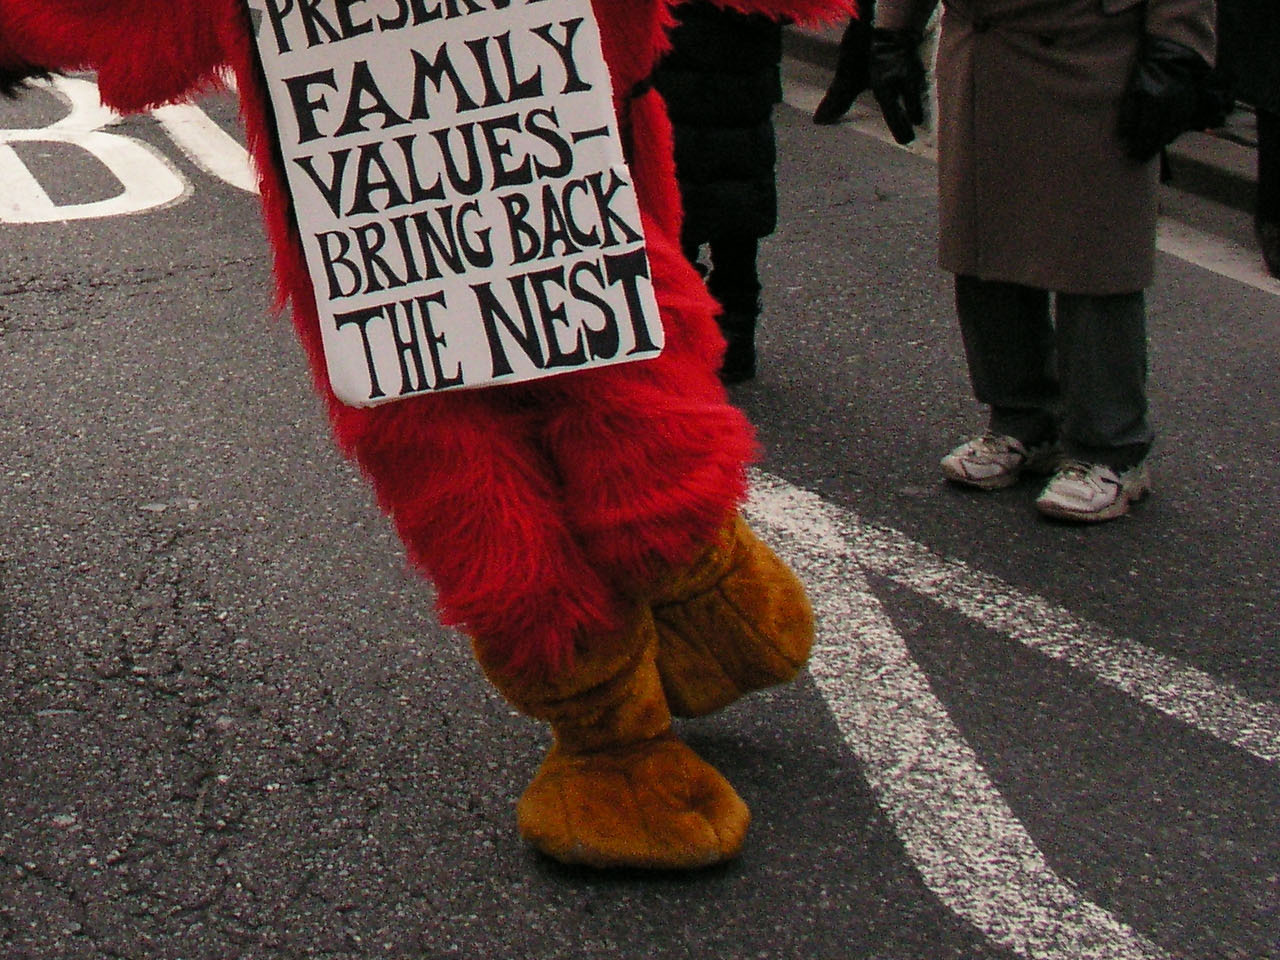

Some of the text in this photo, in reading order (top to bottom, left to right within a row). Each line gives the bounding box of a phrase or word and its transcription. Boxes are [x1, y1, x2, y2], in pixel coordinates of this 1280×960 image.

[281, 17, 592, 145] FAMILY
[314, 168, 644, 301] BRING BACK
[334, 252, 662, 399] THE NEST
